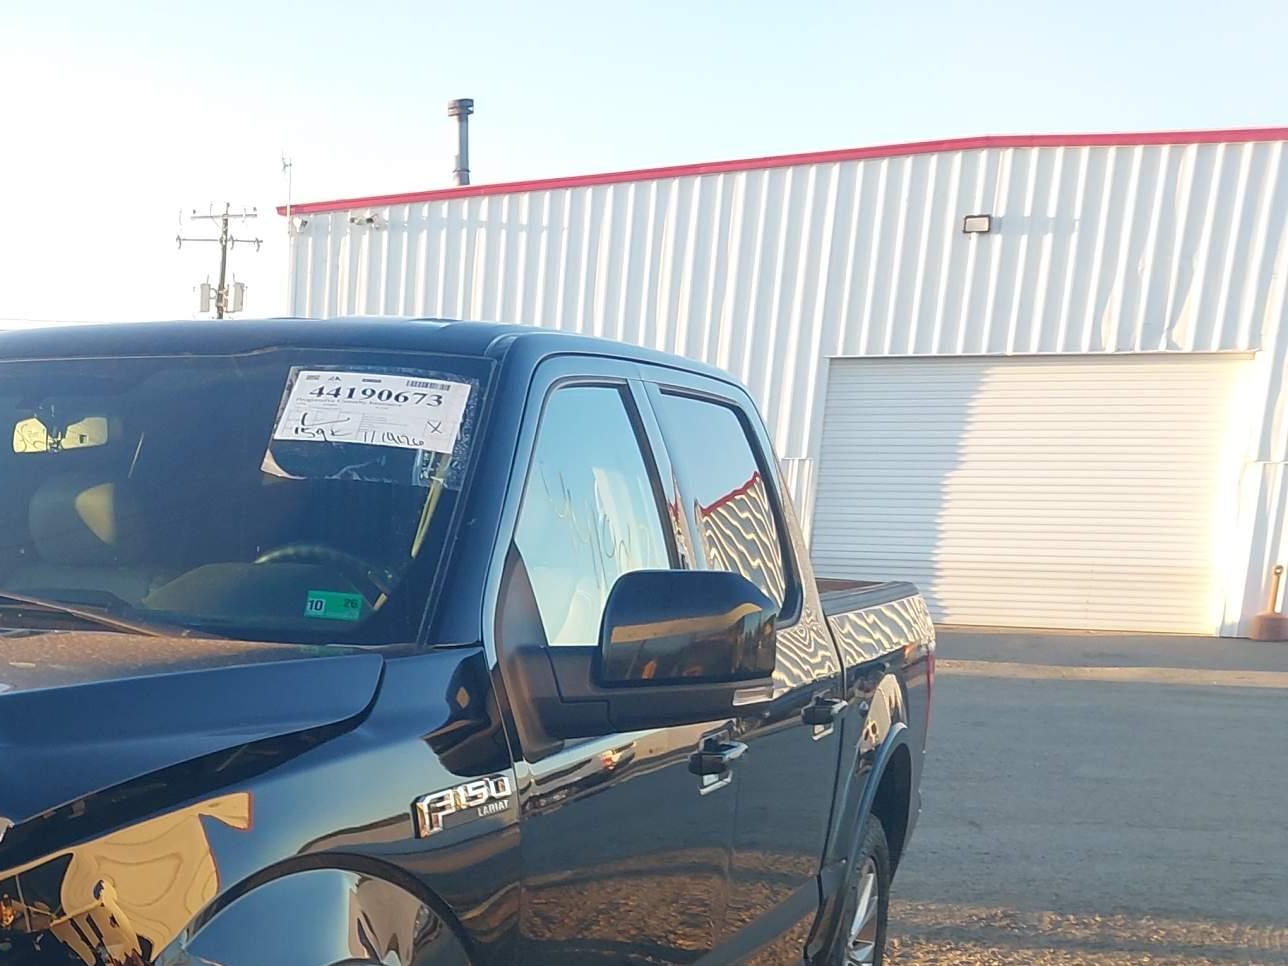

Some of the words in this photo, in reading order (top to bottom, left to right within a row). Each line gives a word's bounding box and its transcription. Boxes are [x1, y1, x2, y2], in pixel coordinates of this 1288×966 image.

[309, 385, 443, 408] 44190673
[308, 599, 324, 611] 10
[477, 799, 510, 817] LARIAT
